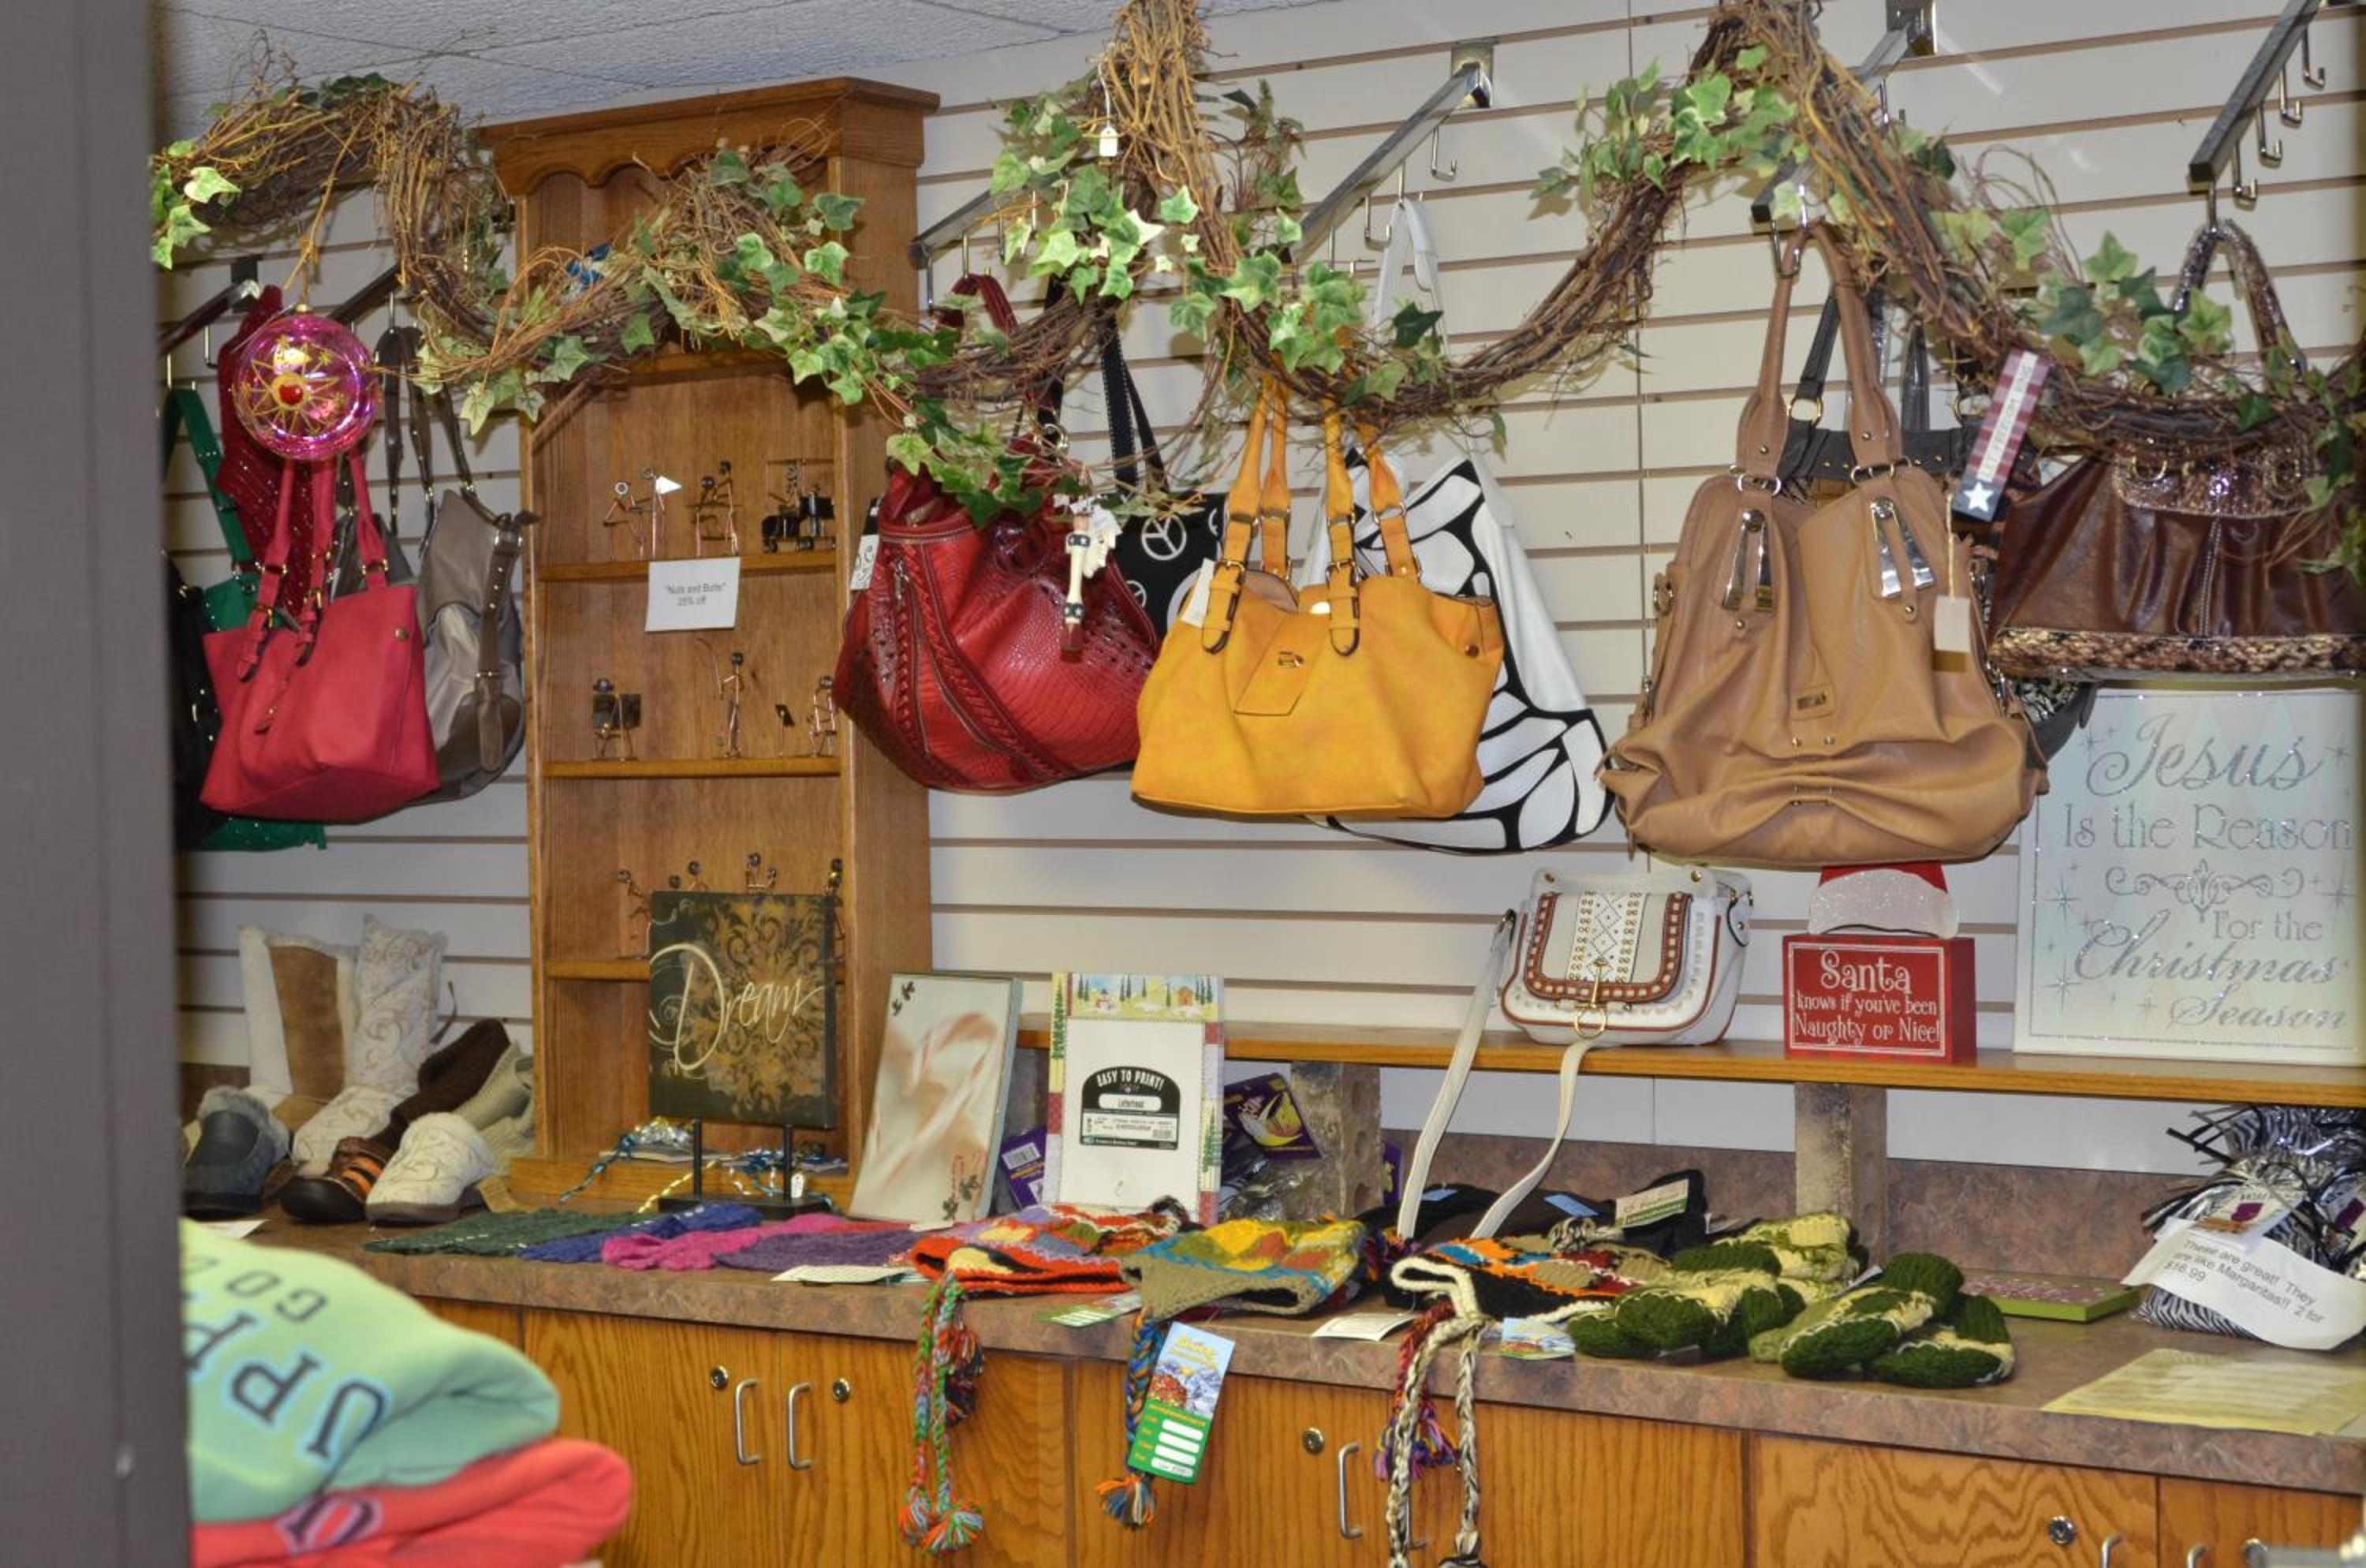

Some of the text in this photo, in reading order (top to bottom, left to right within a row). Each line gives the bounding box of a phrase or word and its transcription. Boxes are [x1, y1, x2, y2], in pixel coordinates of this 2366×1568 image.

[2086, 711, 2323, 797] Jesus
[2065, 800, 2353, 850] Is the Reason
[2074, 909, 2338, 984] Christmas
[2213, 911, 2323, 942] For the
[1820, 950, 1912, 993] Santa
[1797, 990, 1937, 1017] knows if you've been
[2166, 983, 2347, 1030] Season
[1795, 1013, 1866, 1045] Naughty
[1899, 1017, 1941, 1043] Nice!
[1096, 1070, 1165, 1092] EASY TO PRINT!
[2219, 1252, 2241, 1264] are
[2286, 1282, 2318, 1306] They
[2295, 1305, 2306, 1318] 2
[2306, 1309, 2326, 1323] for
